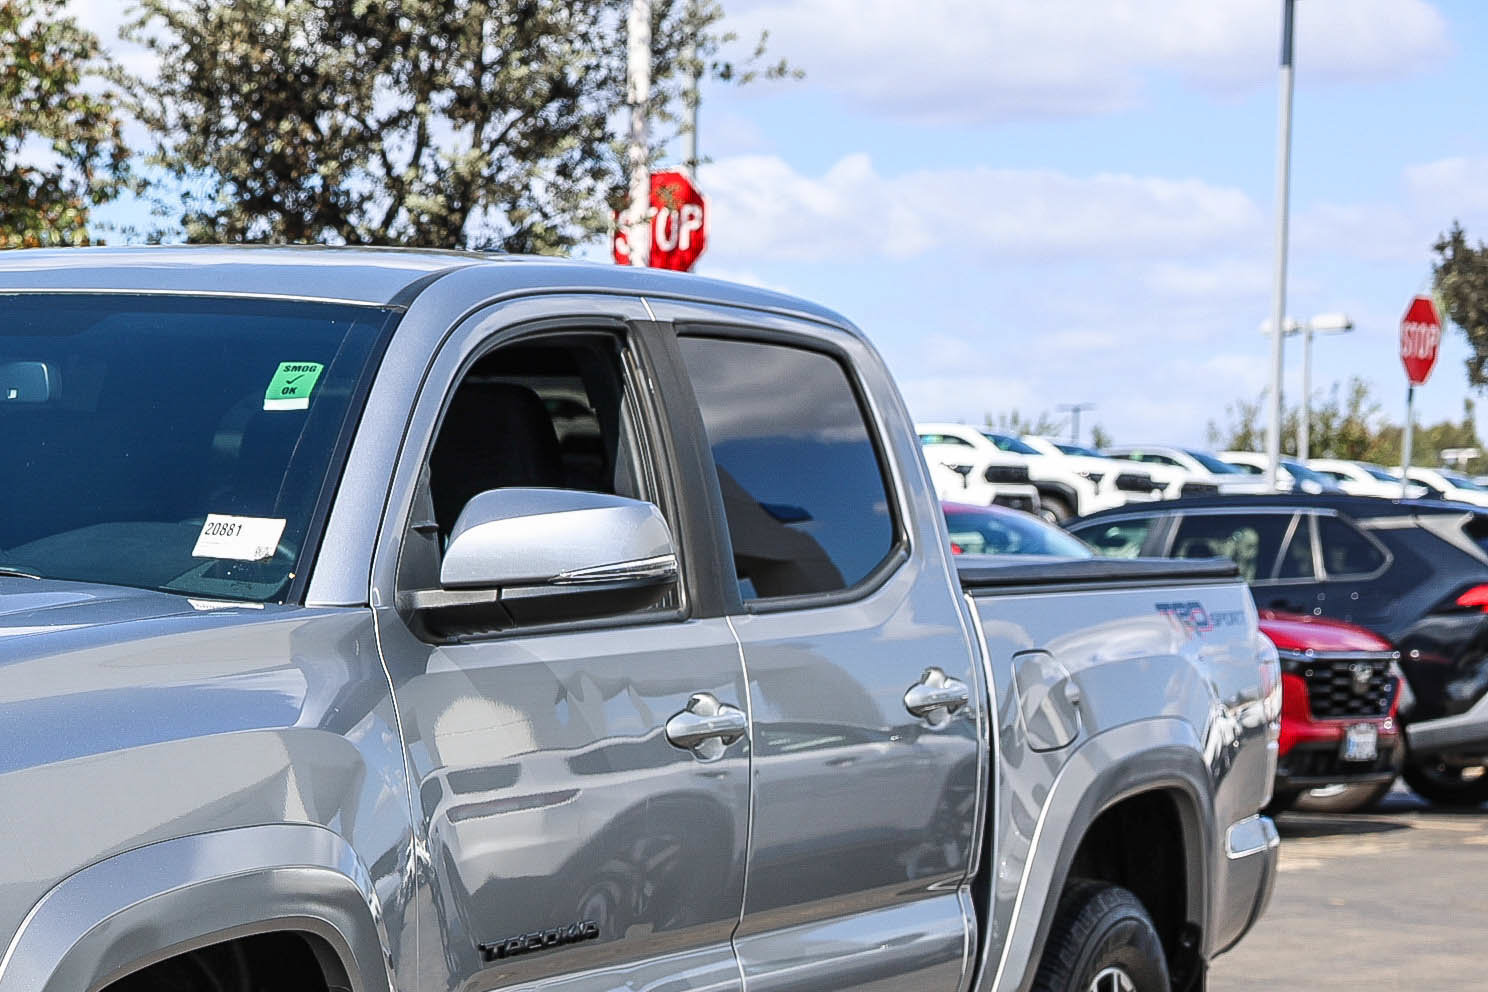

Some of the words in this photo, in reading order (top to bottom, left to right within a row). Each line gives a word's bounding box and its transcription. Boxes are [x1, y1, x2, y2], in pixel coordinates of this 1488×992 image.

[1401, 321, 1440, 359] STOP
[282, 365, 318, 373] SMOG
[281, 386, 298, 395] OK
[204, 522, 243, 537] 20881
